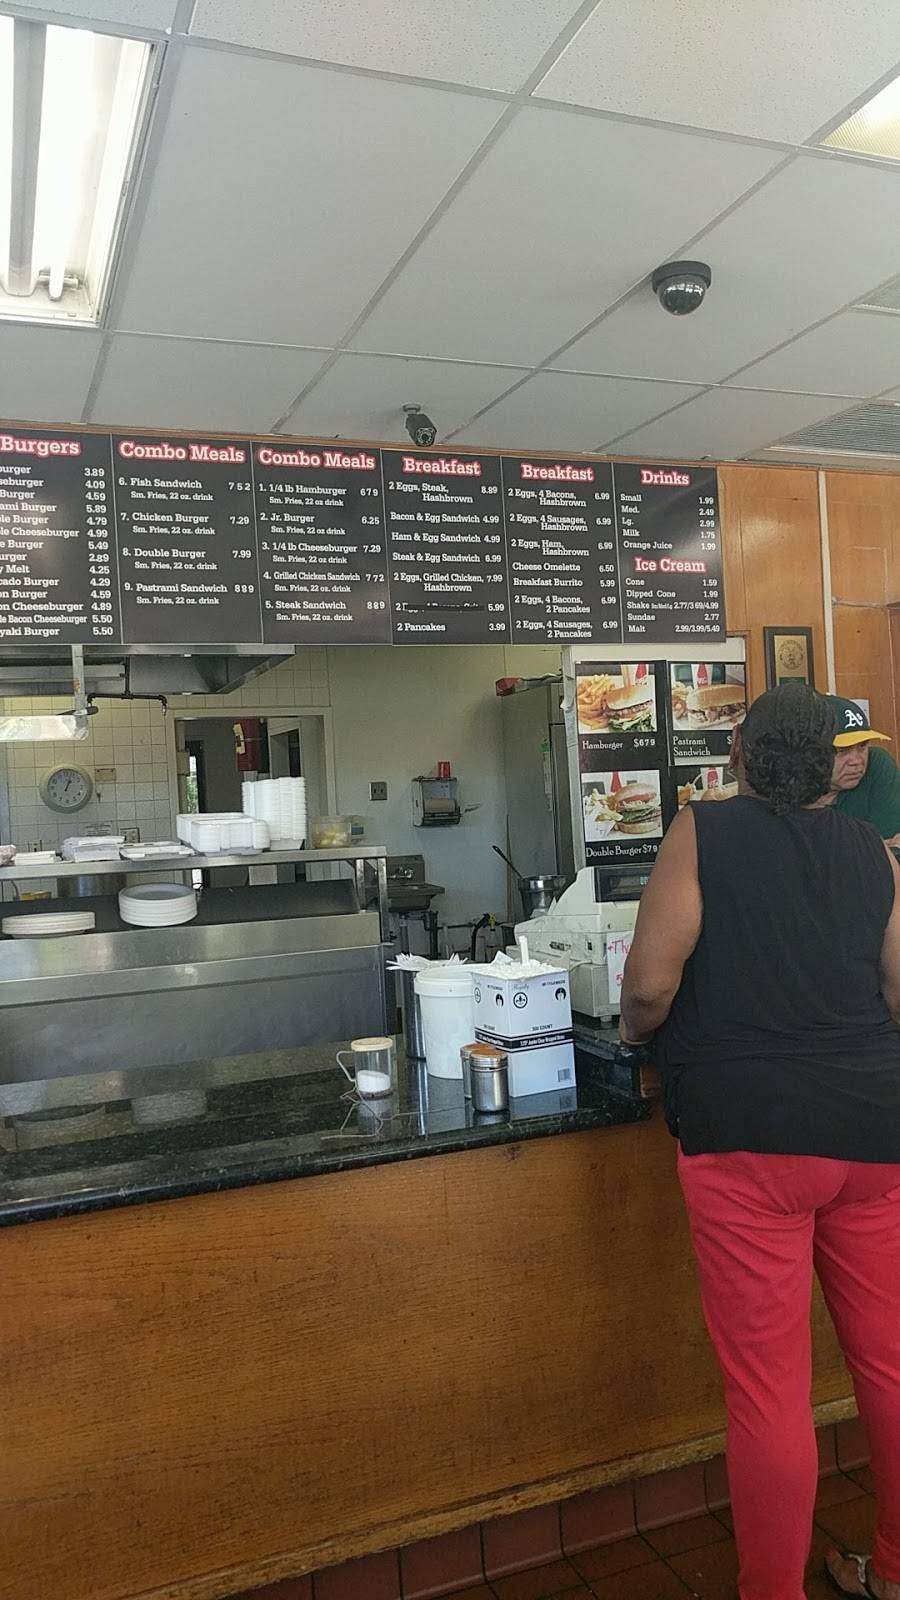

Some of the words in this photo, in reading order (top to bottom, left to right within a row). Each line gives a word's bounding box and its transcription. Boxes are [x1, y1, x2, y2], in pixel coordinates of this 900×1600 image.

[0, 436, 80, 456] Burgers
[120, 442, 186, 460] Combo
[189, 445, 246, 462] Meals
[259, 449, 320, 466] Combo
[324, 451, 375, 469] Meals
[403, 458, 481, 475] Breakfast
[84, 467, 105, 477] 3.89
[521, 464, 594, 481] Breakfast
[641, 470, 690, 486] Drinks
[85, 480, 106, 489] 4.09
[130, 478, 152, 486] Fish
[154, 479, 202, 489] Sandwich
[396, 482, 420, 492] Eggs,
[422, 483, 449, 493] Steak,
[0, 489, 35, 500] Burger
[85, 492, 106, 501] 4.59
[269, 484, 283, 493] 1/4
[296, 485, 347, 496] Hamburger
[515, 488, 537, 498] Eggs,
[545, 490, 576, 499] Bacons,
[423, 493, 473, 503] Hashbrown
[540, 498, 586, 507] Hashbrown
[620, 493, 642, 502] Small
[699, 497, 714, 505] 1.99
[21, 502, 57, 513] Burger
[86, 504, 107, 514] 5.89
[621, 505, 640, 513] Med.
[13, 514, 49, 525] Burger
[86, 517, 107, 526] 4.79
[120, 513, 129, 521] 7.
[132, 513, 173, 522] Chicken
[175, 514, 209, 524] Burger
[230, 516, 250, 525] 7.29
[270, 513, 282, 521] Jr.
[284, 513, 315, 523] Burger
[361, 516, 380, 525] 6.25
[390, 512, 415, 521] Bacon
[425, 513, 440, 523] Egg
[442, 514, 480, 523] Sandwich
[516, 514, 539, 523] Eggs,
[547, 515, 586, 525] Sausages,
[622, 517, 634, 526] Lg.
[699, 520, 715, 528] 2.99
[541, 523, 588, 532] Hashbrown
[11, 528, 80, 539] Cheeseburger
[87, 529, 108, 538] 4.99
[391, 532, 412, 541] Ham
[422, 533, 439, 543] Egg
[440, 534, 481, 543] Sandwich
[622, 529, 640, 537] Milk
[701, 531, 715, 539] 1.75
[8, 540, 44, 550] Burger
[88, 541, 109, 550] 5.49
[273, 543, 286, 551] 1/4
[298, 543, 358, 554] Cheeseburger
[363, 545, 381, 553] 7.29
[623, 541, 651, 550] Orange
[652, 542, 673, 550] Juice
[701, 543, 716, 551] 1.99
[88, 553, 109, 562] 2.89
[122, 548, 131, 556] 8.
[134, 548, 169, 557] Double
[171, 549, 206, 559] Burger
[232, 550, 252, 558] 7.99
[392, 552, 415, 561] Steak
[425, 553, 440, 563] Egg
[442, 554, 481, 562] Sandwich
[485, 555, 502, 563] 6.99
[6, 565, 30, 573] Melt
[89, 566, 110, 574] 4.25
[512, 562, 542, 571] Cheese
[543, 563, 581, 571] Omelette
[599, 565, 615, 573] 6.50
[635, 557, 657, 571] Ice
[660, 558, 706, 573] Cream
[273, 571, 298, 580] Grilled
[298, 572, 327, 580] Chicken
[327, 572, 361, 581] Sandwich
[400, 573, 422, 582] Eggs,
[423, 573, 449, 582] Grilled
[450, 574, 484, 583] Chicken,
[487, 575, 503, 583] 7.99
[24, 577, 60, 588] Burger
[90, 578, 111, 587] 4.29
[513, 578, 552, 586] Breakfast
[554, 578, 583, 586] Burrito
[625, 578, 645, 586] Cone
[702, 579, 718, 587] 1.59
[124, 583, 133, 591] 9.
[136, 583, 179, 592] Pastrami
[180, 584, 228, 593] Sandwich
[424, 583, 473, 592] Hashbrown
[12, 590, 48, 600] Burger
[90, 590, 111, 599] 4.59
[626, 590, 653, 599] Dipped
[656, 590, 676, 598] Cone
[521, 595, 544, 605] Eggs,
[552, 595, 583, 604] Bacons,
[601, 597, 617, 605] 6.99
[13, 602, 84, 612] Cheeseburger
[91, 602, 112, 611] 4.89
[275, 601, 301, 609] Steak
[302, 601, 347, 610] Sandwich
[553, 605, 590, 613] Pancakes
[8, 615, 33, 623] Bacon
[34, 614, 87, 624] Cheeseburger
[92, 614, 113, 623] 5.50
[627, 613, 656, 621] Sundae
[704, 613, 720, 621] 2.77
[24, 627, 60, 637] Burger
[92, 627, 114, 636] 5.50
[404, 623, 446, 631] Pancakes
[489, 623, 506, 631] 3.99
[628, 625, 646, 633] Malt
[582, 740, 623, 750] Hamburger
[673, 736, 706, 745] Pastrami
[673, 746, 711, 756] Sandwich
[586, 846, 615, 858] Double
[615, 845, 642, 856] Burger
